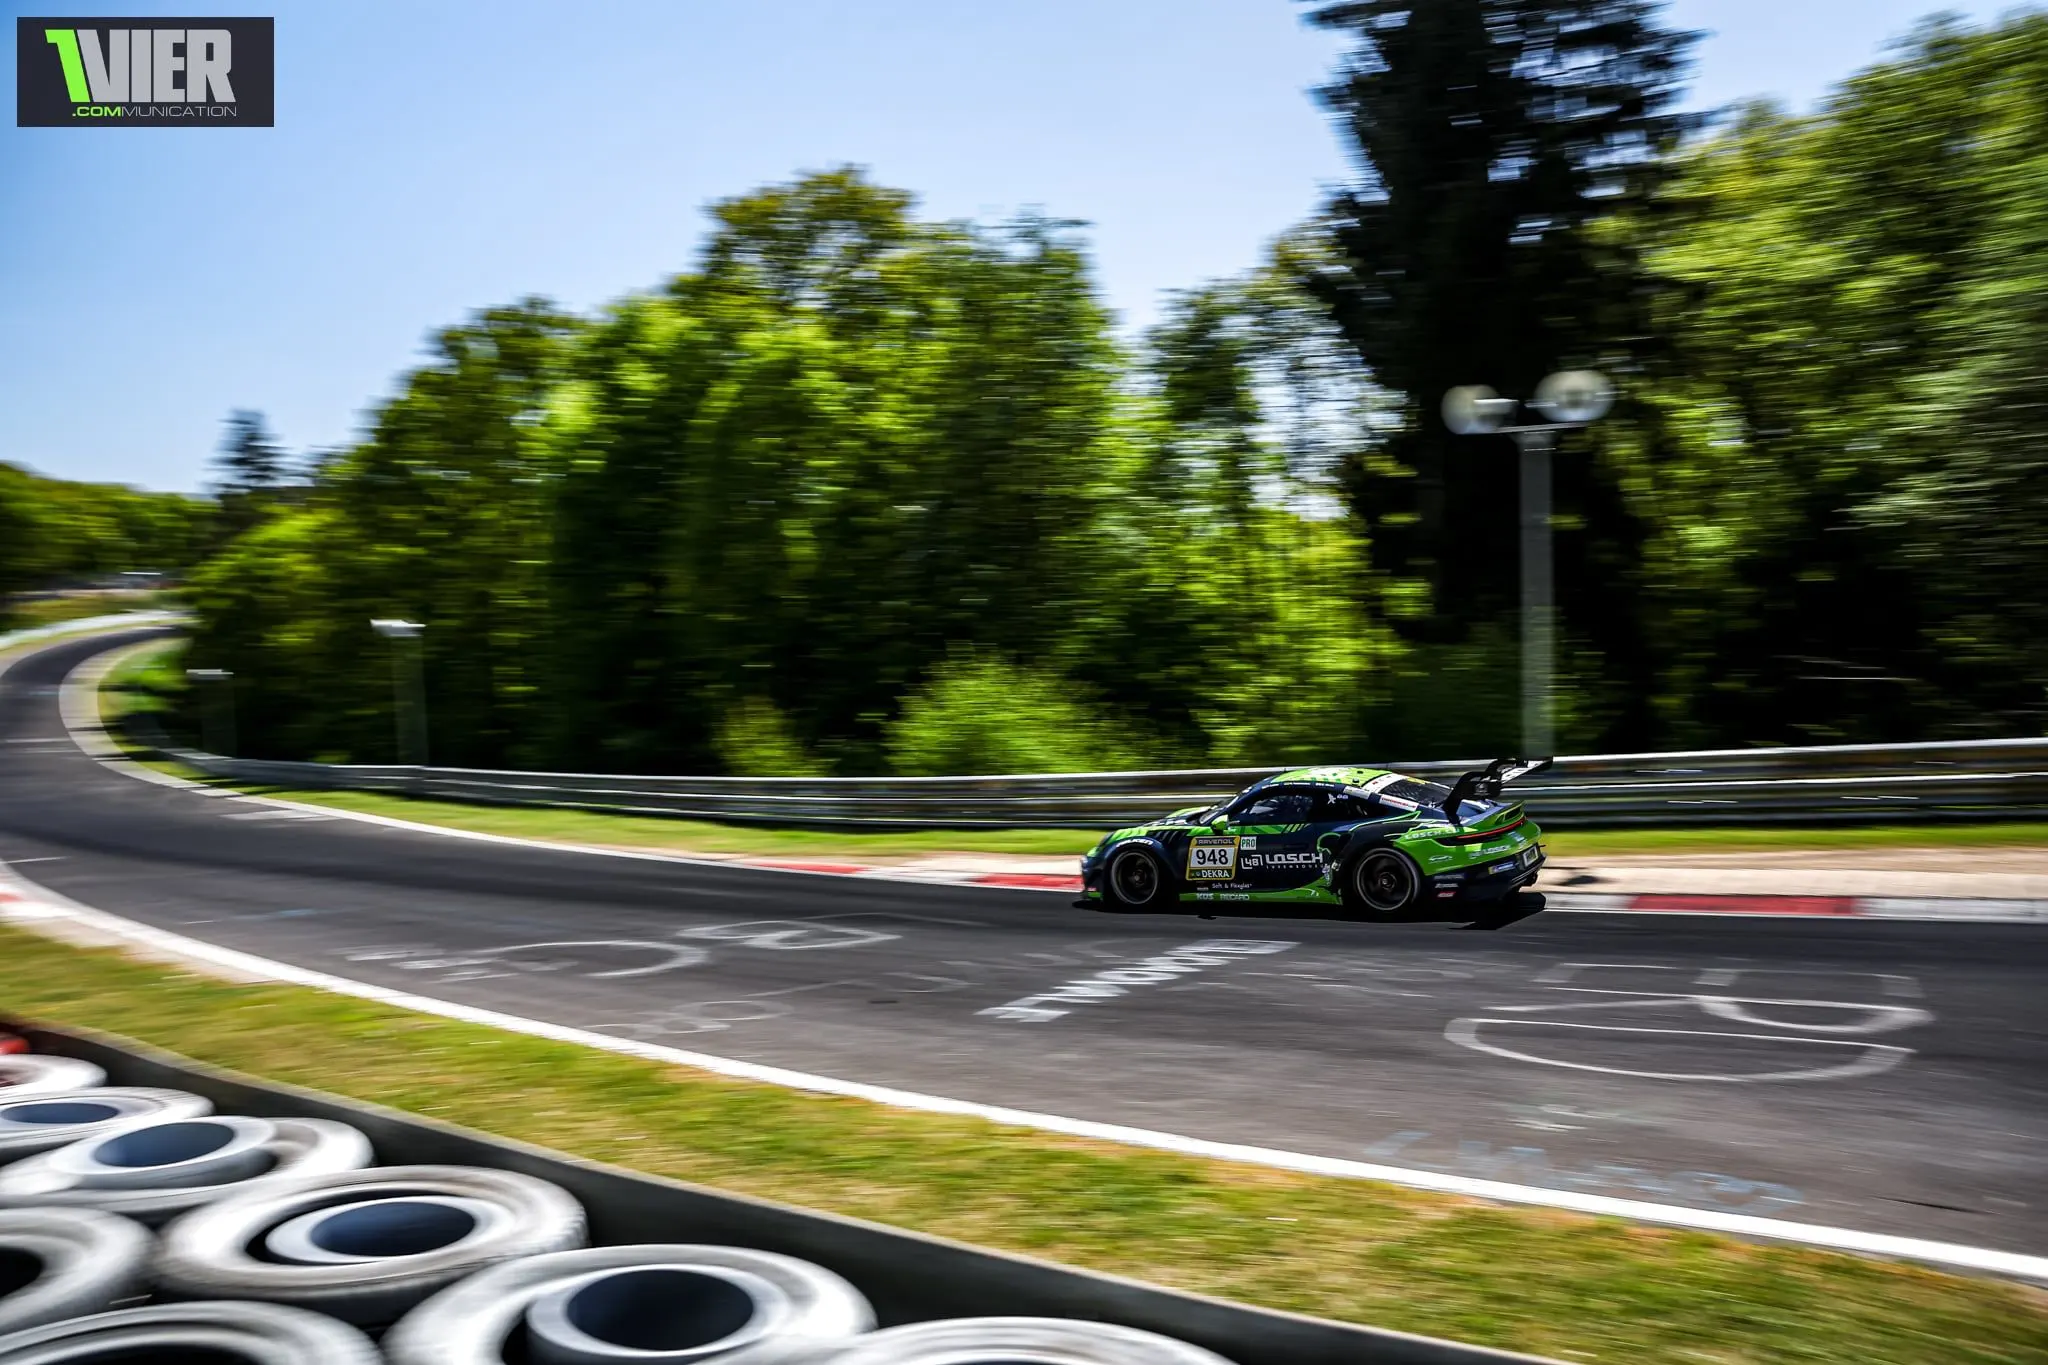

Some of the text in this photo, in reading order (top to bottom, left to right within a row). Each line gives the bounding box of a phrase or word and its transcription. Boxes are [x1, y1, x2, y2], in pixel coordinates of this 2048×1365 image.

[1241, 838, 1256, 848] PRO
[1196, 849, 1229, 865] 948
[1265, 853, 1323, 864] LOSCH
[1202, 870, 1230, 878] DEKRA
